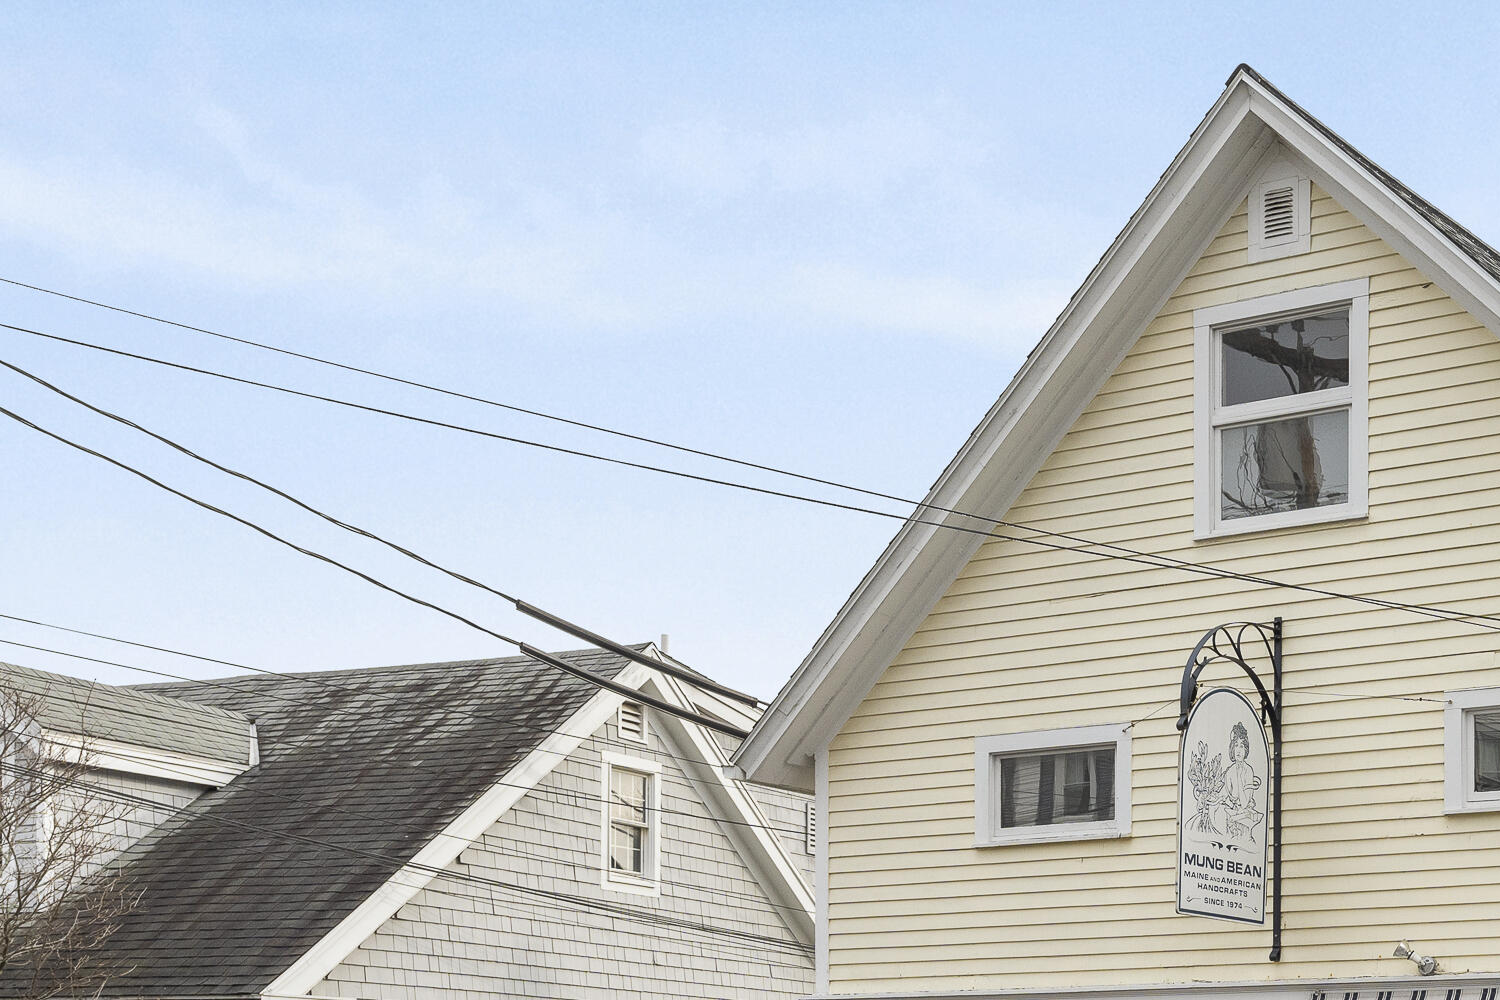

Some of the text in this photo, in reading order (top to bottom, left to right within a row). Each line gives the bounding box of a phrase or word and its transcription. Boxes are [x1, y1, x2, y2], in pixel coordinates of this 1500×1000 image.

[1184, 852, 1262, 878] MUNG BEAN
[1183, 870, 1209, 881] MAINE
[1220, 877, 1261, 890] AMERICAN
[1197, 882, 1248, 898] HANDCRAFTS
[1204, 897, 1243, 909] SINCE 1974
